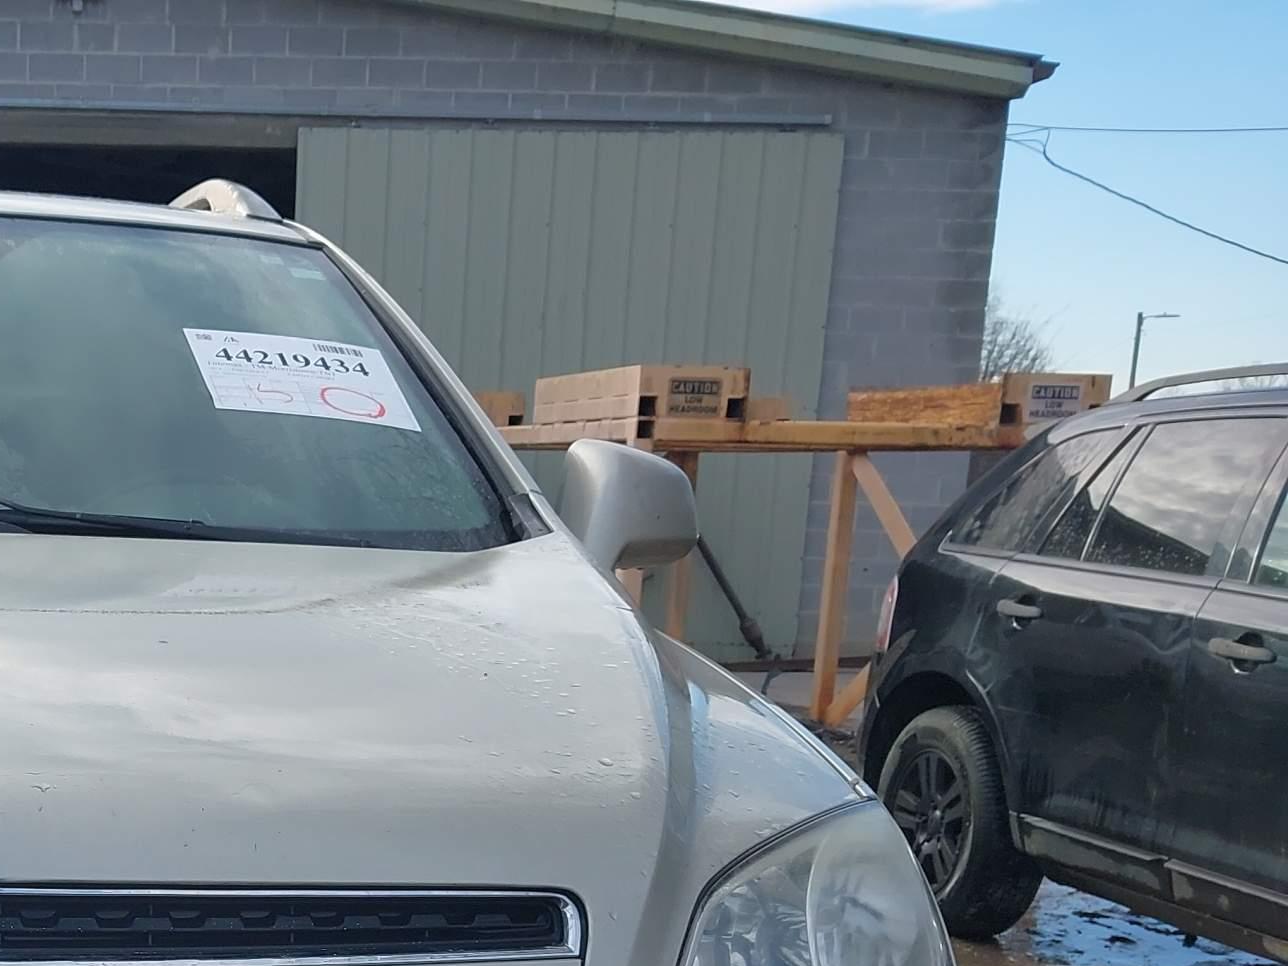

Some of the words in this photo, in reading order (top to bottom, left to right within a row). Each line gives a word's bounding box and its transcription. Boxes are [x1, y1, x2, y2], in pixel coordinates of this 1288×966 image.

[215, 347, 370, 377] 44219434
[672, 381, 719, 393] CAUTION
[1033, 386, 1079, 398] CAUTION
[684, 396, 703, 404] LOW
[1044, 401, 1064, 409] LOW
